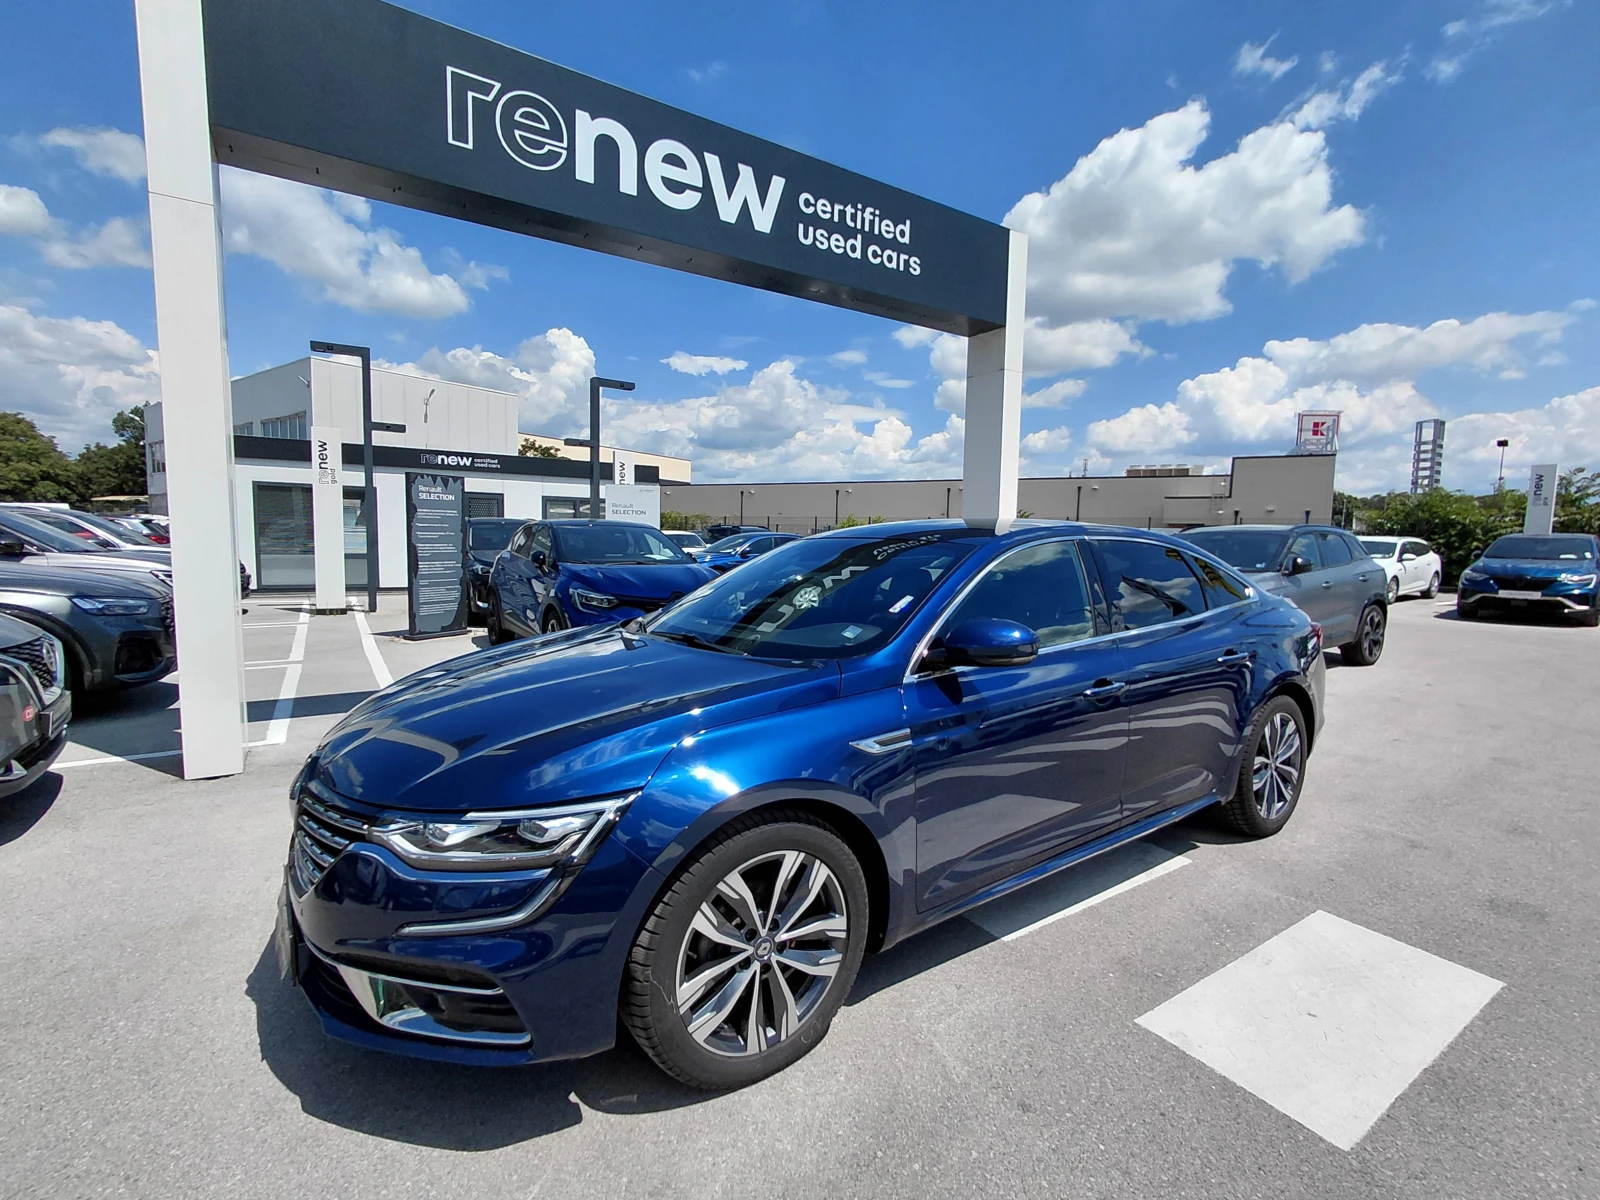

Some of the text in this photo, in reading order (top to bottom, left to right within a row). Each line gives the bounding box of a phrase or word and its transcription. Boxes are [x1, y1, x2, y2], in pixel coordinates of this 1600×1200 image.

[446, 65, 787, 234] renew
[798, 192, 911, 245] certified
[797, 222, 922, 277] used cars
[317, 439, 330, 485] renew
[420, 453, 473, 467] renew
[329, 468, 338, 485] gold
[418, 484, 443, 493] Renault
[418, 492, 455, 501] SELECTION
